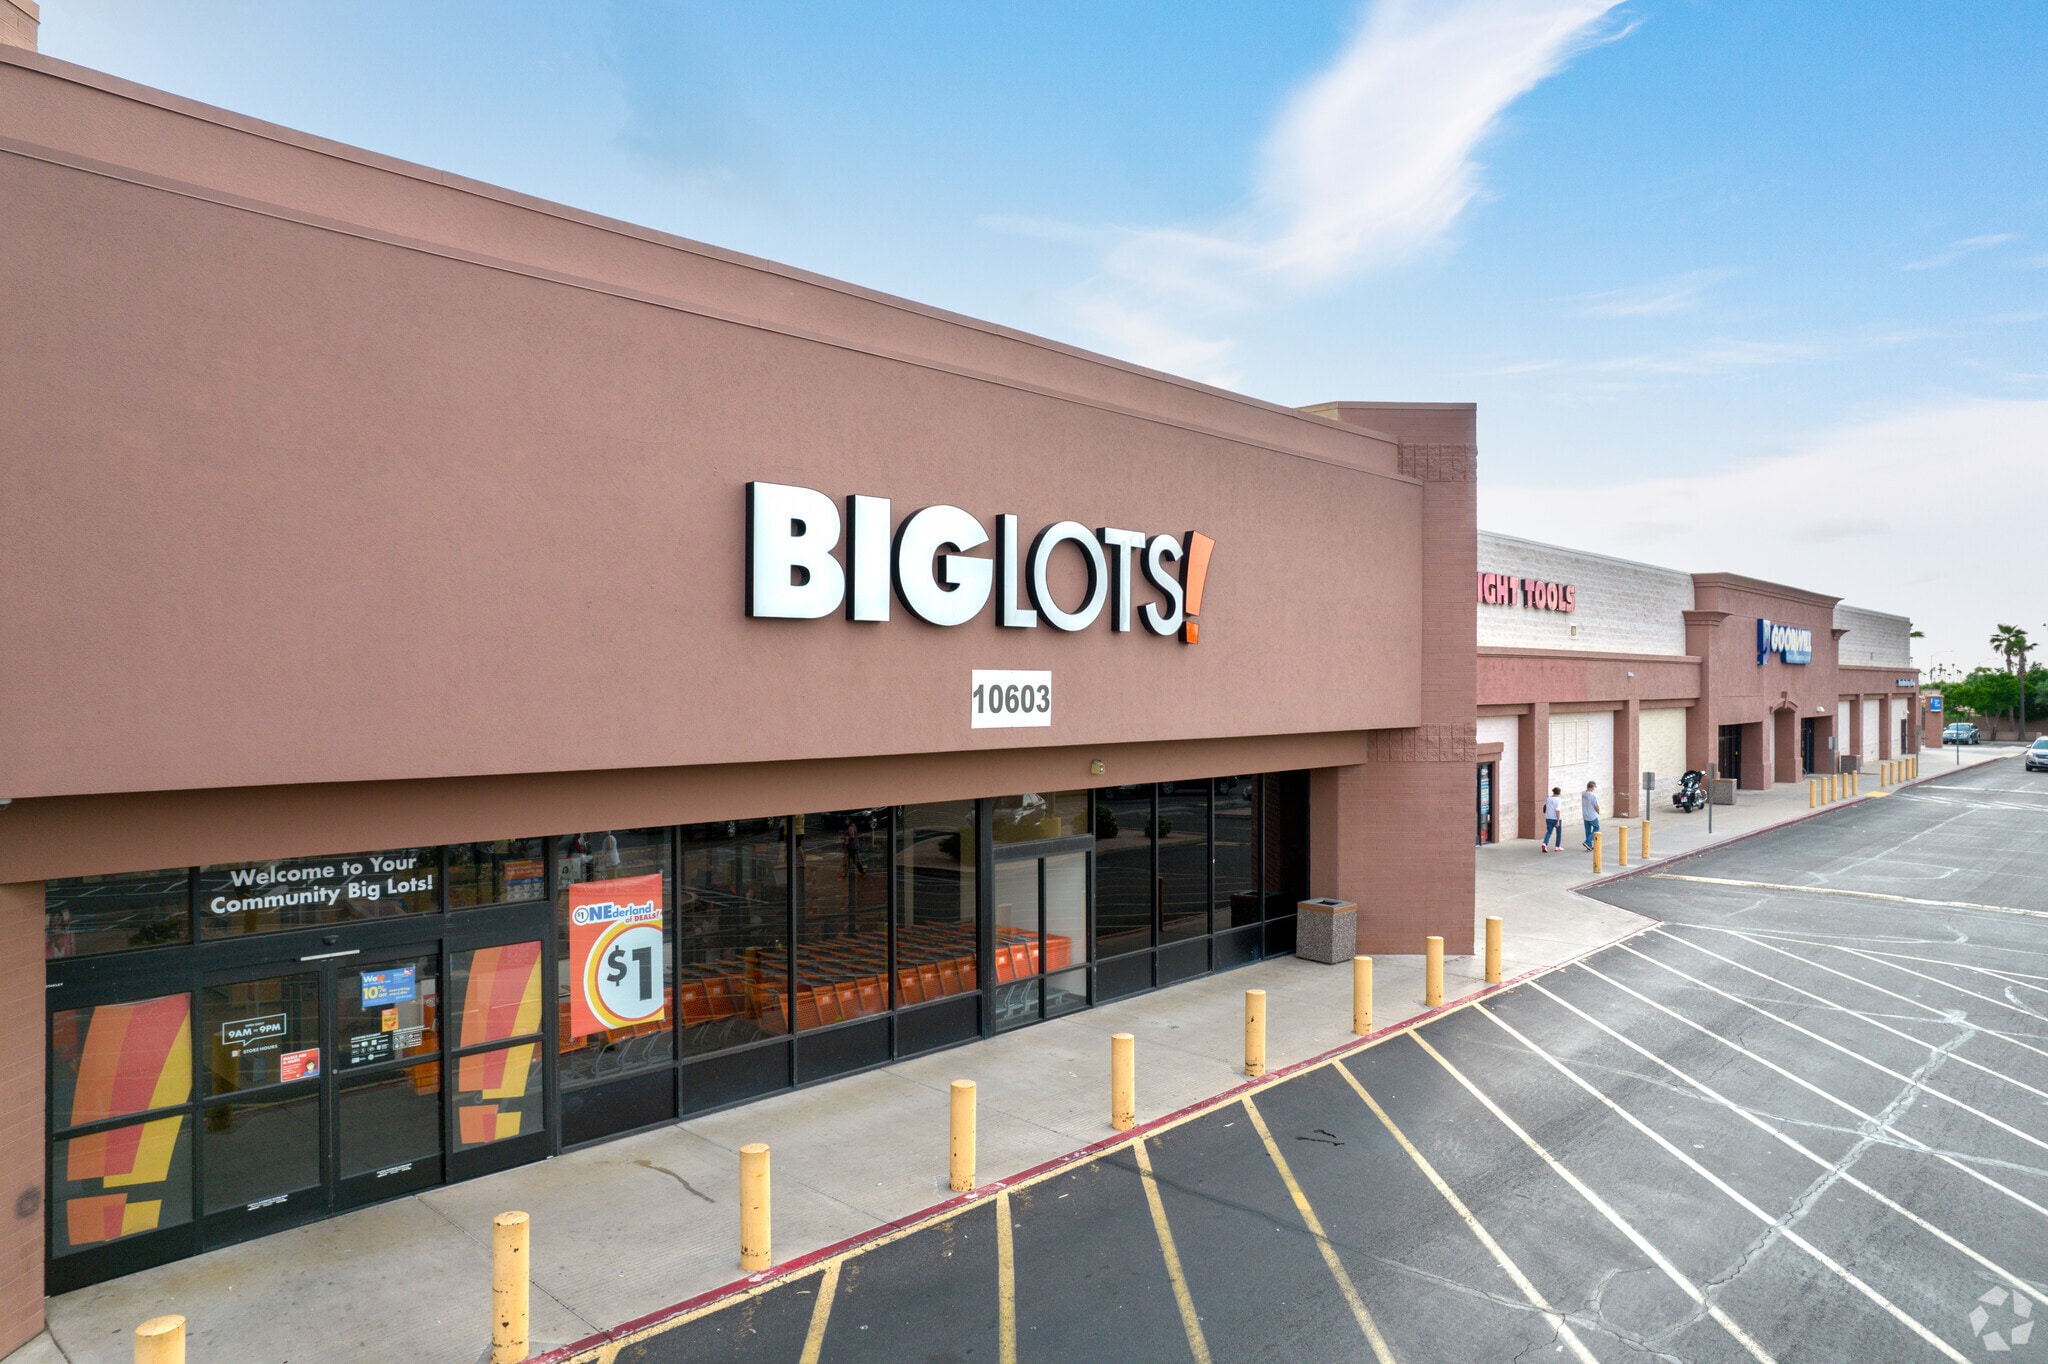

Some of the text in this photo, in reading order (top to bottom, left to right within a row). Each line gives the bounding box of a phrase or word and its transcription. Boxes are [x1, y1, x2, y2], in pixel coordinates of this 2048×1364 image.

[1521, 579, 1575, 613] TOOLS
[973, 684, 1050, 714] 10603
[230, 856, 417, 887] Welcome to Your
[210, 874, 433, 914] Community Big Lots!
[625, 911, 660, 923] of DEALS!
[606, 945, 653, 1001] $1
[228, 1028, 252, 1039] 9AM
[259, 1023, 281, 1034] 9PM
